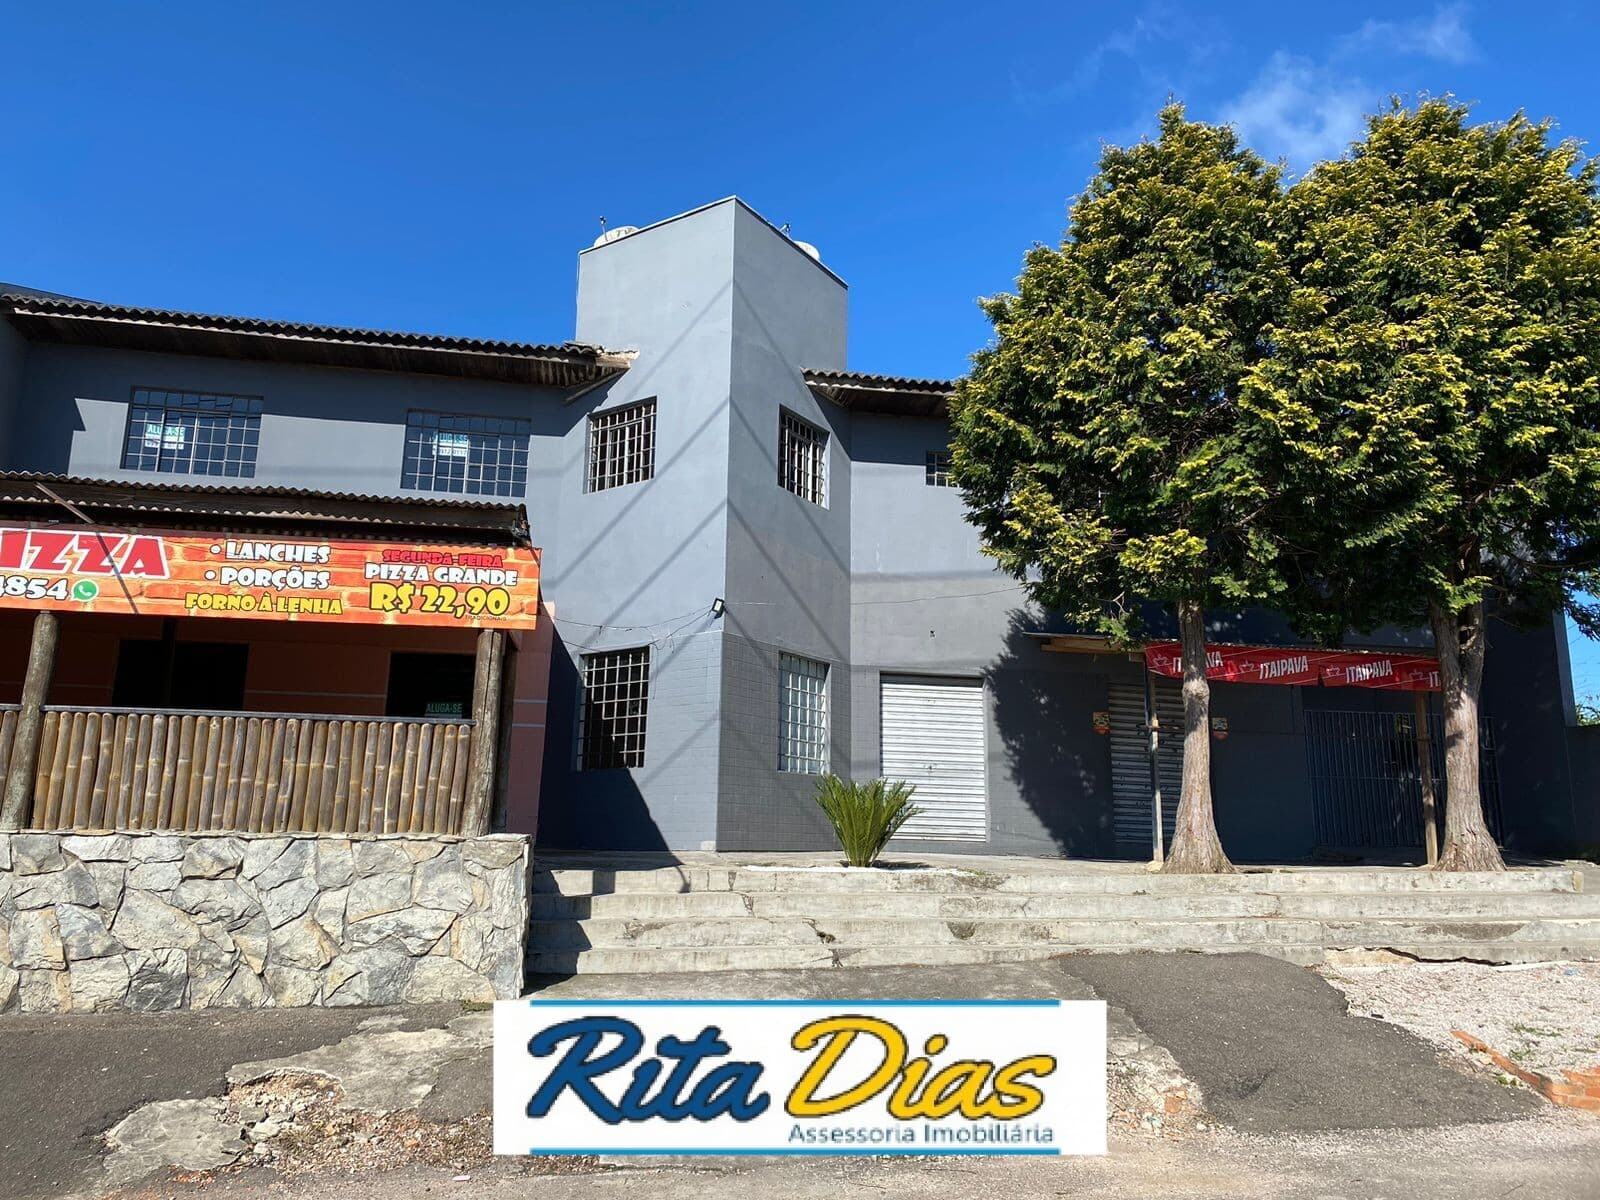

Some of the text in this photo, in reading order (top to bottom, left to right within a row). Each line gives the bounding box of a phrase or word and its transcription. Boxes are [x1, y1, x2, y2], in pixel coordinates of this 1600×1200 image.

[0, 528, 169, 578] IZZA
[225, 540, 332, 564] LANCHES
[382, 549, 503, 568] SEGUNDA-FEIRA
[220, 565, 331, 591] PORÇÕES
[364, 562, 519, 587] PIZZA GRANDE
[0, 575, 69, 600] 854
[184, 591, 343, 615] FORNO À LENHA
[369, 582, 511, 619] R$ 22,90
[1259, 655, 1309, 680] ITAIPAVA
[1345, 660, 1393, 684] ITAIPAVA
